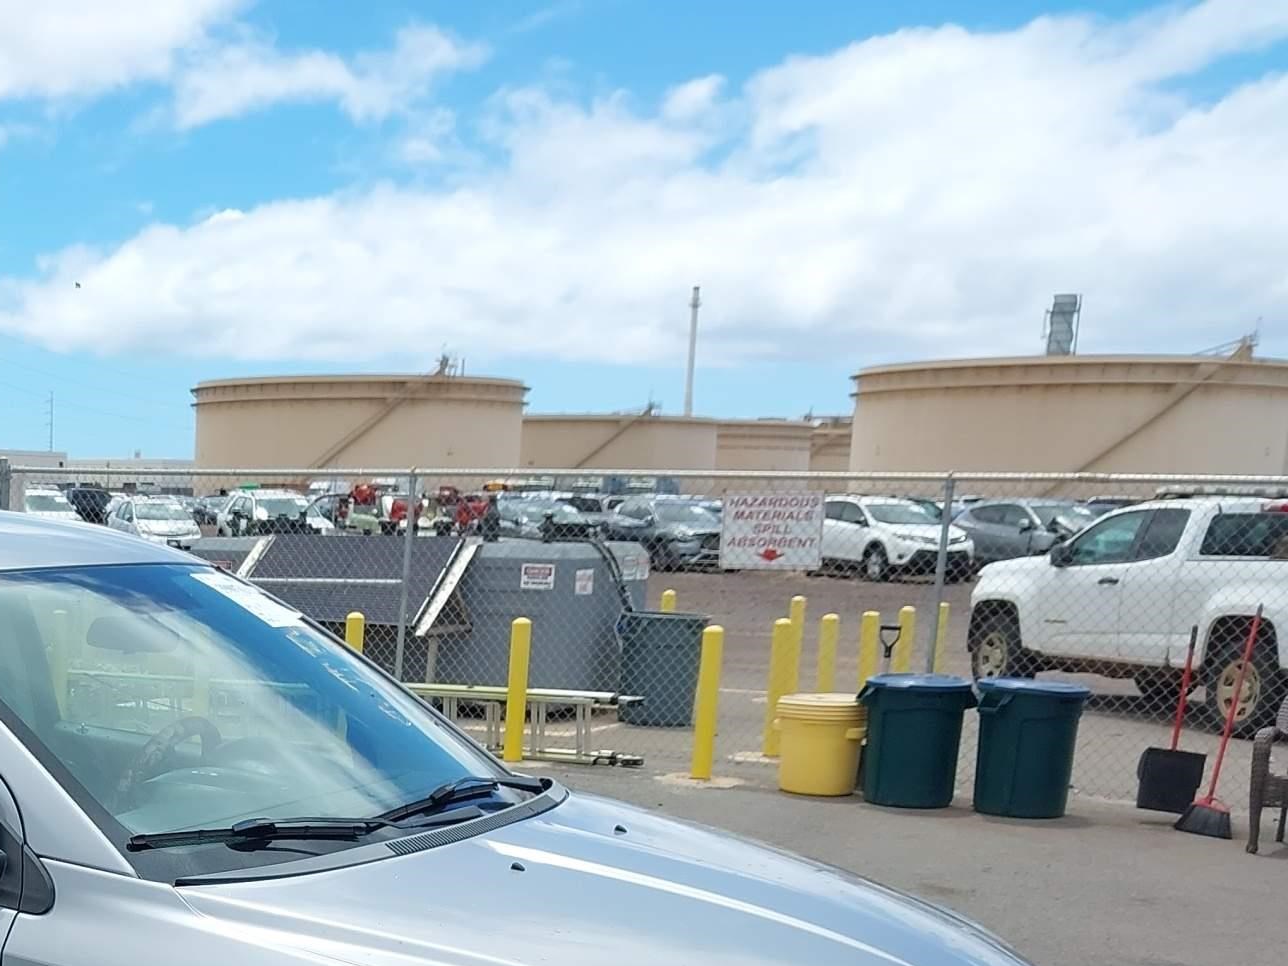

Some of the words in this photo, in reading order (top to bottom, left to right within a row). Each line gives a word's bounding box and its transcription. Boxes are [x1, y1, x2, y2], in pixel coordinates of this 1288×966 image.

[729, 496, 819, 508] HAZARDOUS
[733, 510, 815, 521] MATERIALS
[753, 523, 793, 534] SPILL
[727, 536, 817, 548] ABSORBENT
